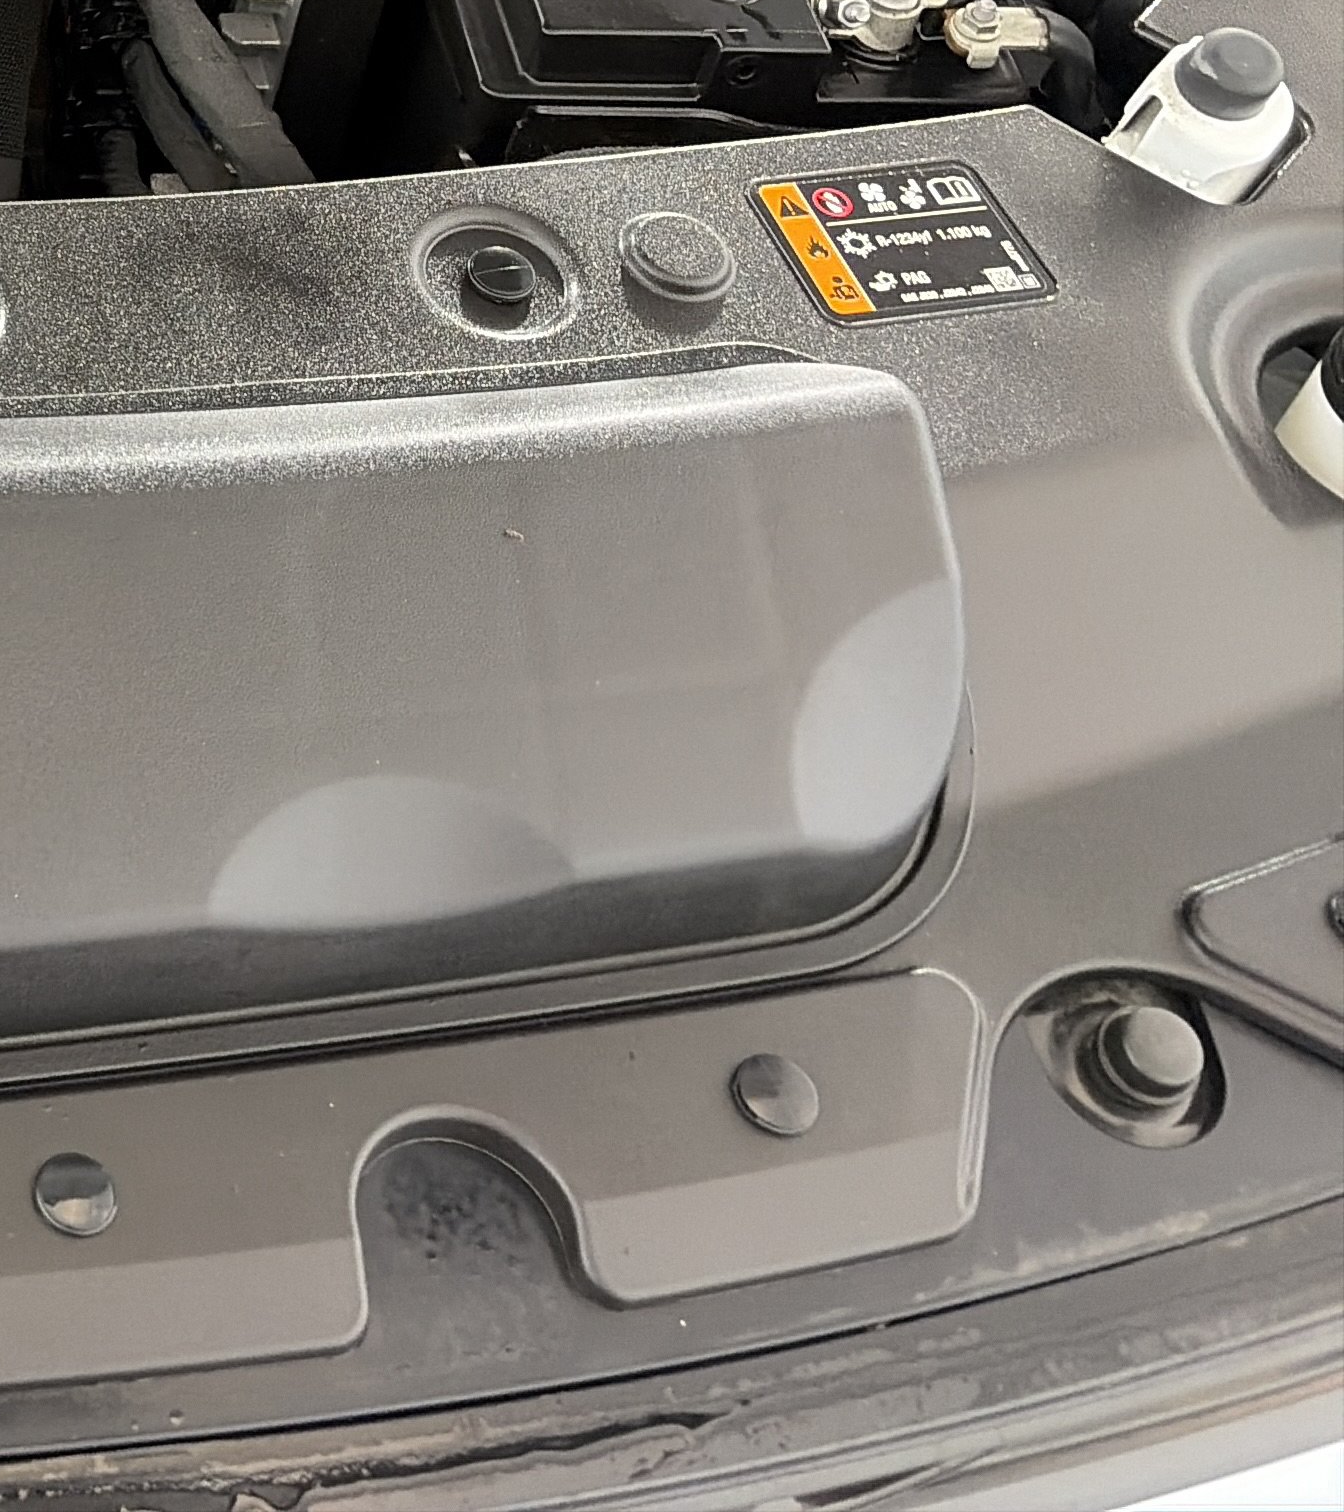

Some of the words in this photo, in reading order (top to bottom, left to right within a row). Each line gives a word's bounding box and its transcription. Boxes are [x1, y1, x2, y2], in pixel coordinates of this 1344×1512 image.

[867, 201, 898, 214] AUTO
[936, 226, 971, 240] 1.100
[971, 225, 992, 239] kg
